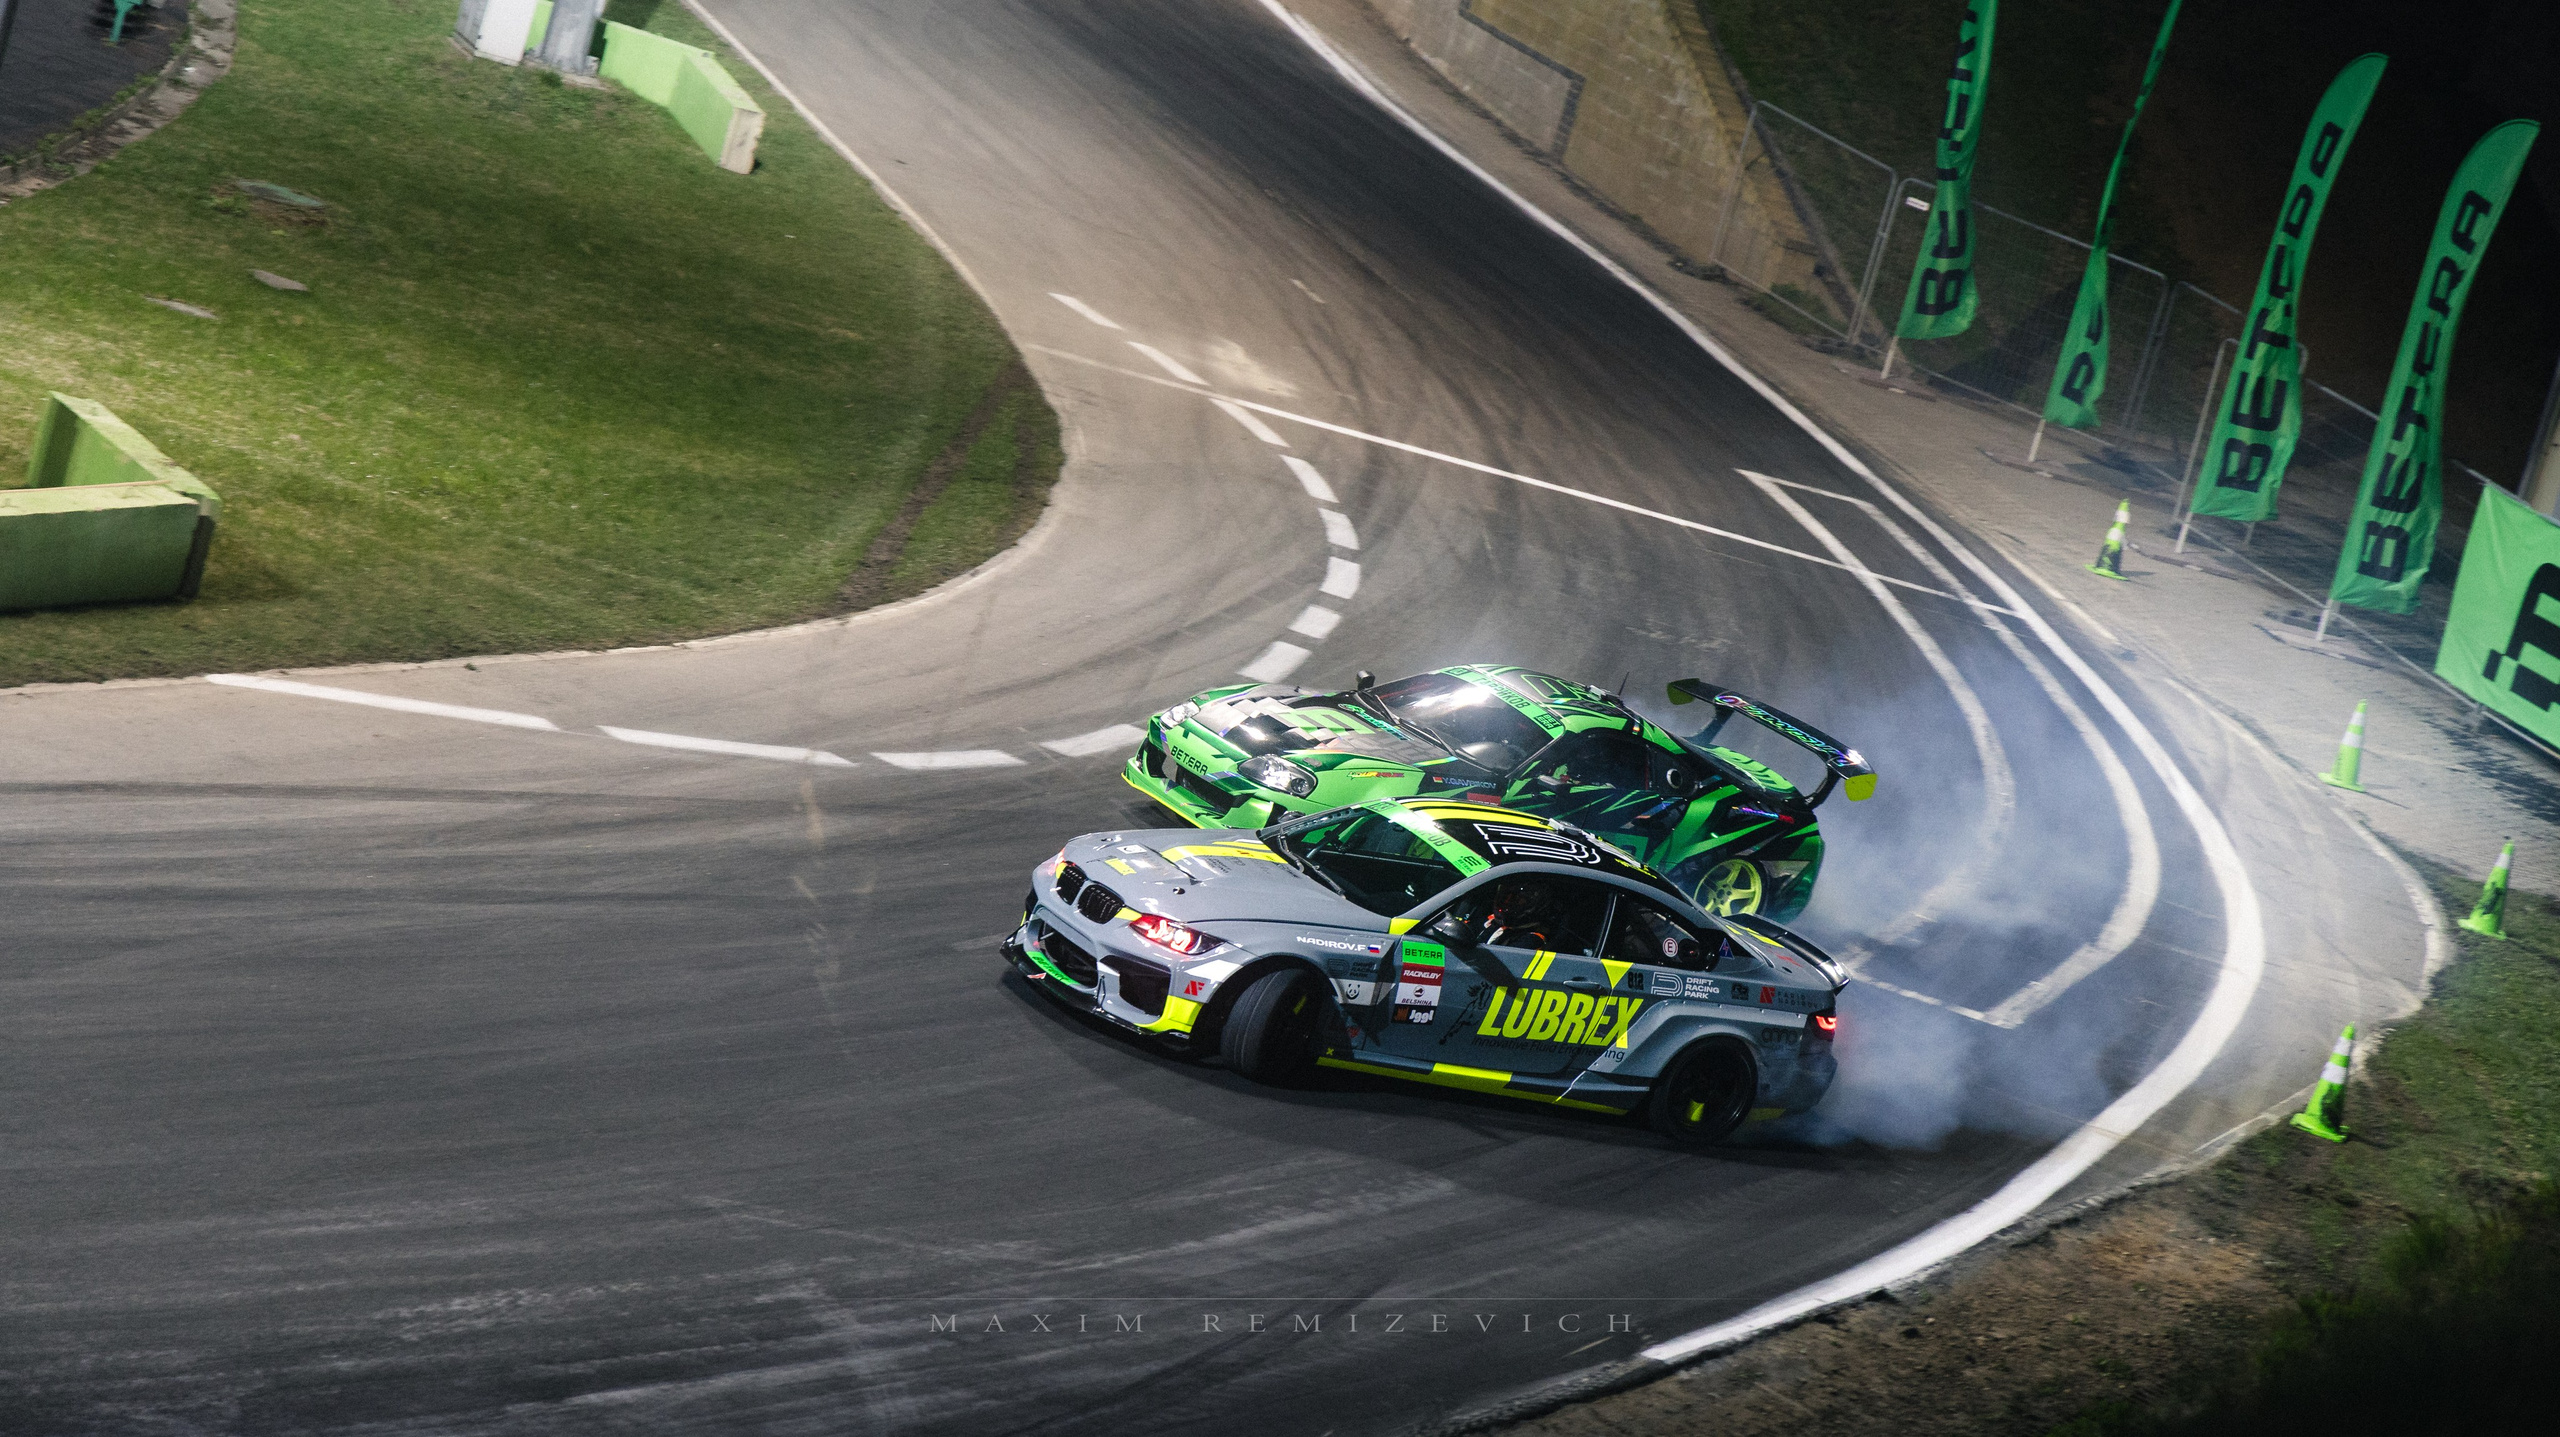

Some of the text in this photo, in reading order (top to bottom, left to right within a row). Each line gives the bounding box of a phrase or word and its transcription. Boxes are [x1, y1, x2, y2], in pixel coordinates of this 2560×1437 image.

[2356, 189, 2494, 583] BETERA
[1170, 745, 1209, 775] BETERA
[1296, 936, 1367, 952] NADIROV.F
[1404, 948, 1444, 960] BETERA
[1686, 977, 1714, 986] DRIFT
[1685, 984, 1720, 994] RACING
[1684, 991, 1709, 1000] PARK
[1401, 998, 1433, 1006] BELSHINA
[1477, 986, 1644, 1049] LUBREX
